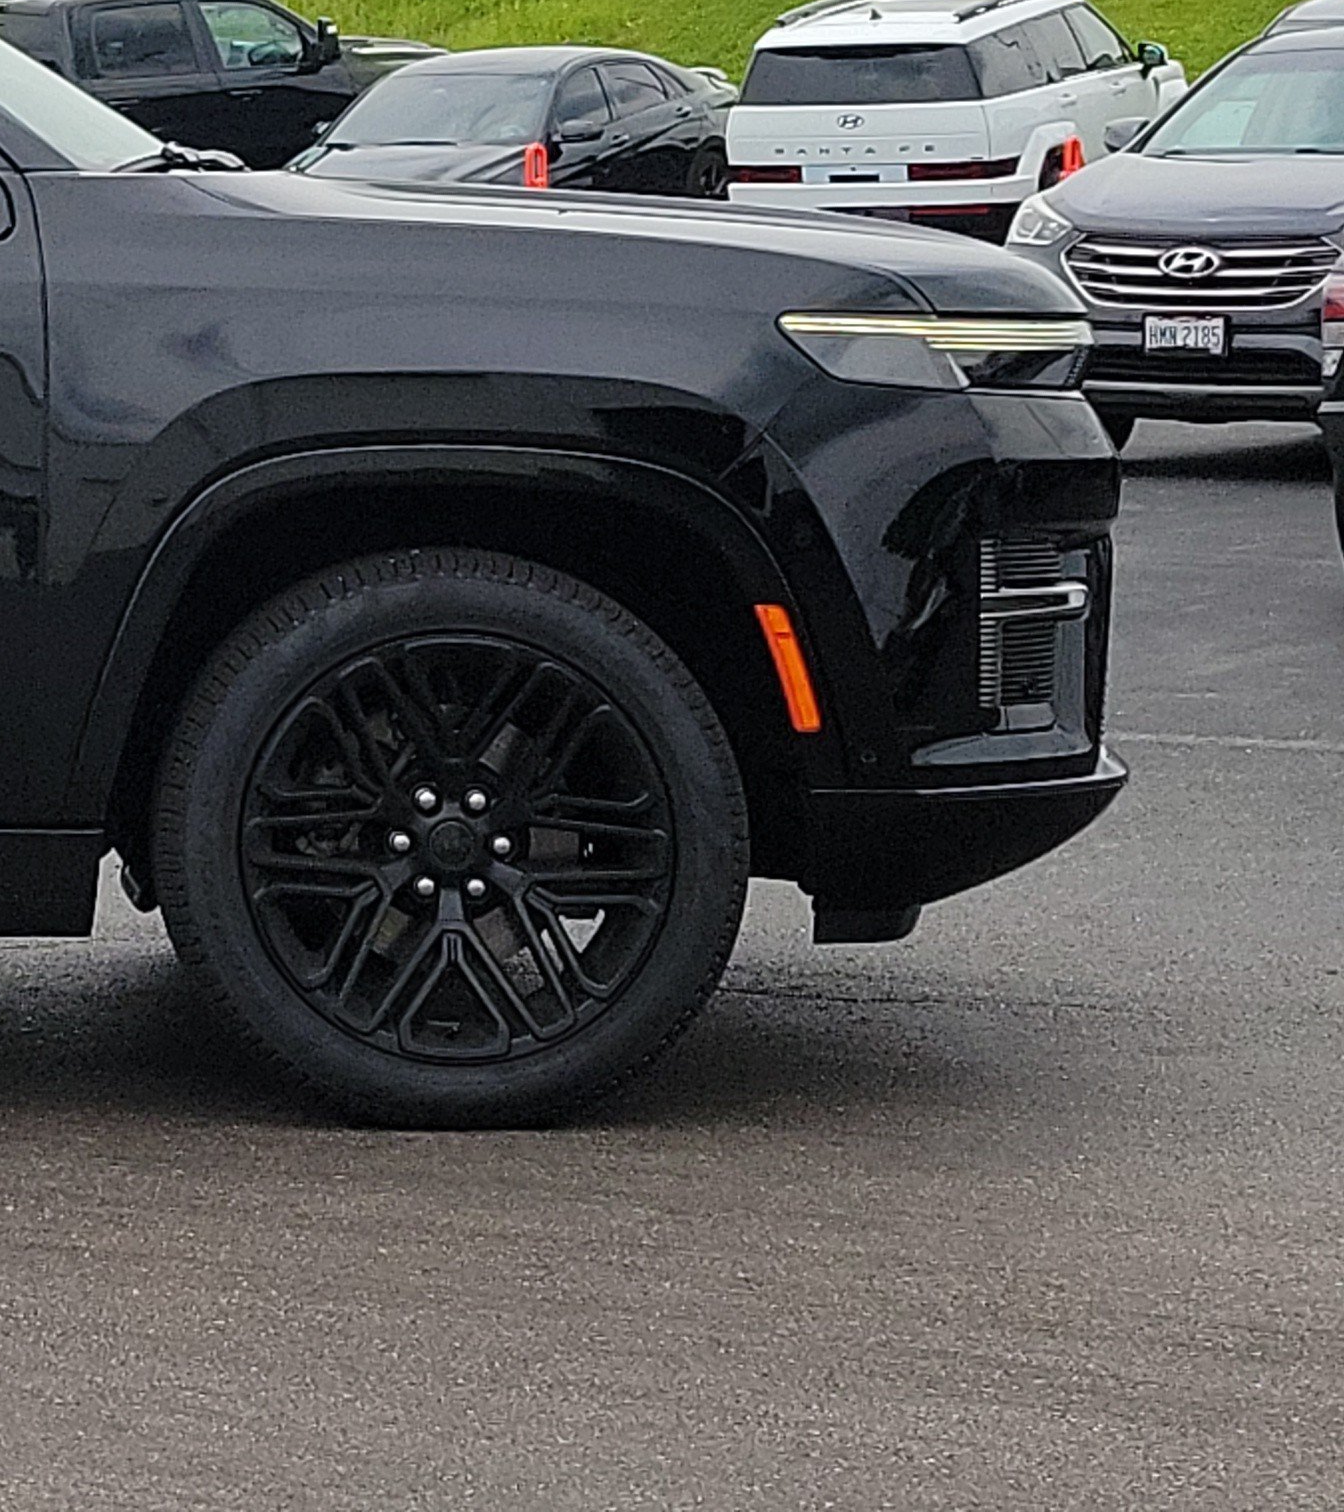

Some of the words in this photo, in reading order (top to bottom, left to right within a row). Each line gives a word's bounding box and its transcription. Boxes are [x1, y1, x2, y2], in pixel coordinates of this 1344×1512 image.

[774, 145, 876, 155] SANTA
[898, 144, 934, 153] FE
[1181, 325, 1221, 348] 2185
